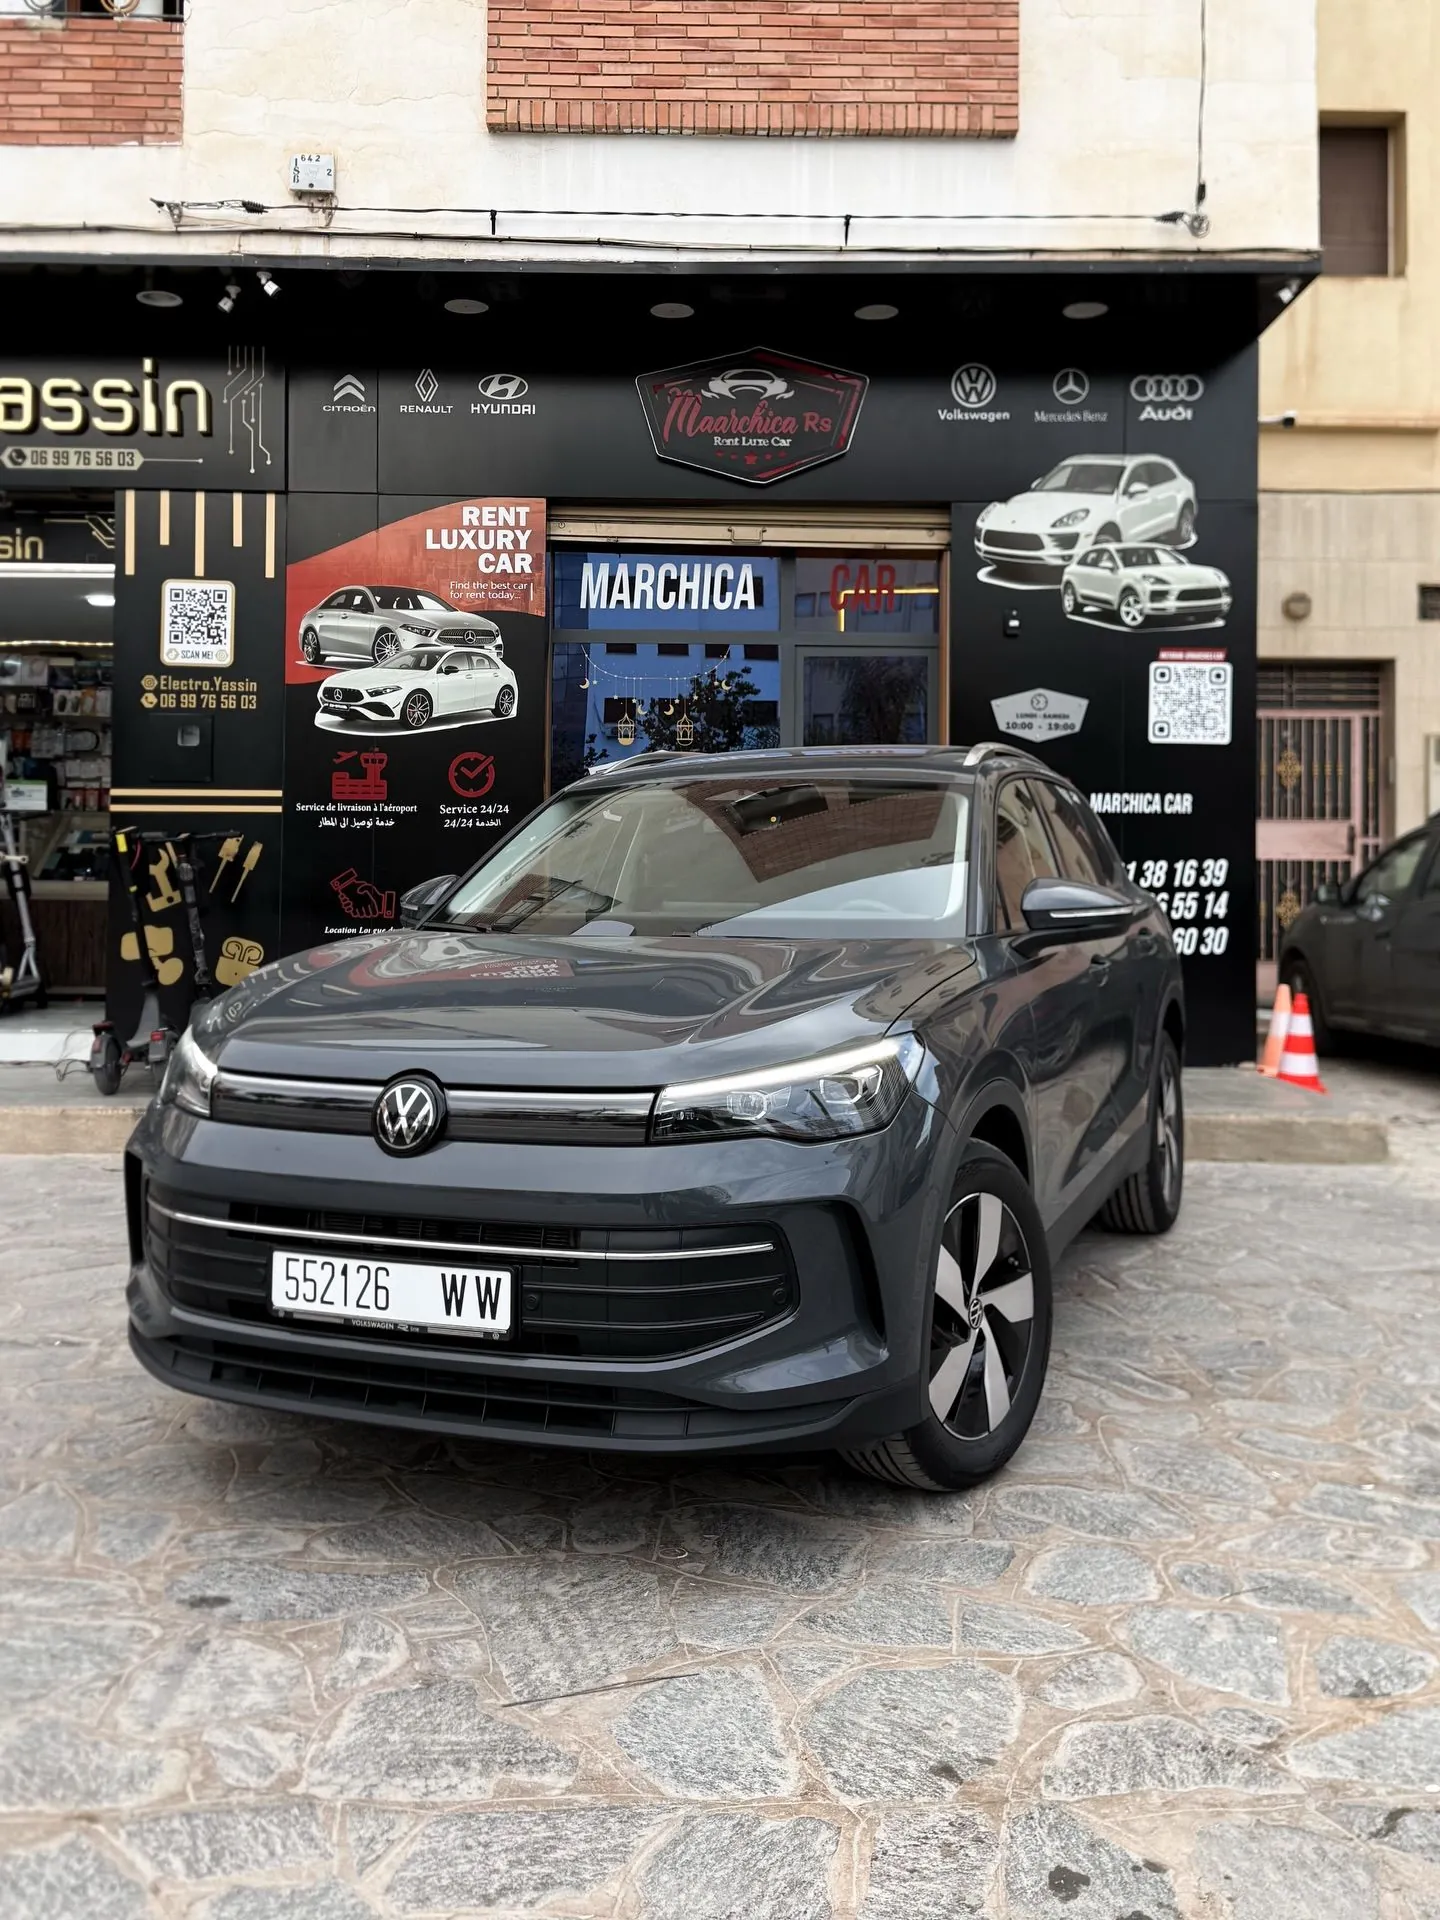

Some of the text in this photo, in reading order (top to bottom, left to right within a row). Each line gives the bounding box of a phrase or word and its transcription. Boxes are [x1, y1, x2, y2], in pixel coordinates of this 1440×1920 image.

[400, 404, 454, 415] RENAULT
[471, 402, 537, 416] HYUNDAI
[937, 408, 1011, 423] Volkswagen
[1139, 404, 1194, 422] Audi
[713, 436, 793, 448] Rent Luxe Car
[30, 450, 135, 467] 06 99 76 56 03
[462, 506, 530, 527] RENT
[426, 528, 532, 550] LUXURY
[478, 552, 533, 574] CAR
[449, 580, 528, 590] Find the best car
[580, 562, 897, 613] MARCHICA CAR
[449, 590, 521, 602] for rent today...
[180, 650, 214, 660] SCAN ME!
[160, 675, 258, 692] Electro.Yassin
[160, 693, 257, 710] 06 99 76 56 03
[1005, 721, 1034, 730] 10:00
[1047, 722, 1076, 731] 19:00
[295, 802, 325, 812] Service
[326, 802, 336, 812] de
[337, 802, 372, 812] livraison
[379, 802, 418, 814] l'aéroport
[439, 802, 510, 815] Service 24/24
[1089, 792, 1193, 815] MARCHICA CAR
[318, 816, 337, 828] المطار
[350, 817, 373, 829] توصيل
[375, 816, 395, 827] خدمة
[443, 817, 501, 828] الخدمة 24/24
[1139, 859, 1168, 888] 38
[1173, 858, 1199, 888] 16
[1199, 858, 1229, 887] 39
[1170, 891, 1199, 920] 55
[1204, 890, 1230, 920] 14
[324, 926, 357, 934] Location
[1199, 926, 1229, 955] 30
[285, 1257, 390, 1311] 552126
[441, 1273, 502, 1320] WW
[351, 1319, 395, 1330] VOLKSWAGEN
